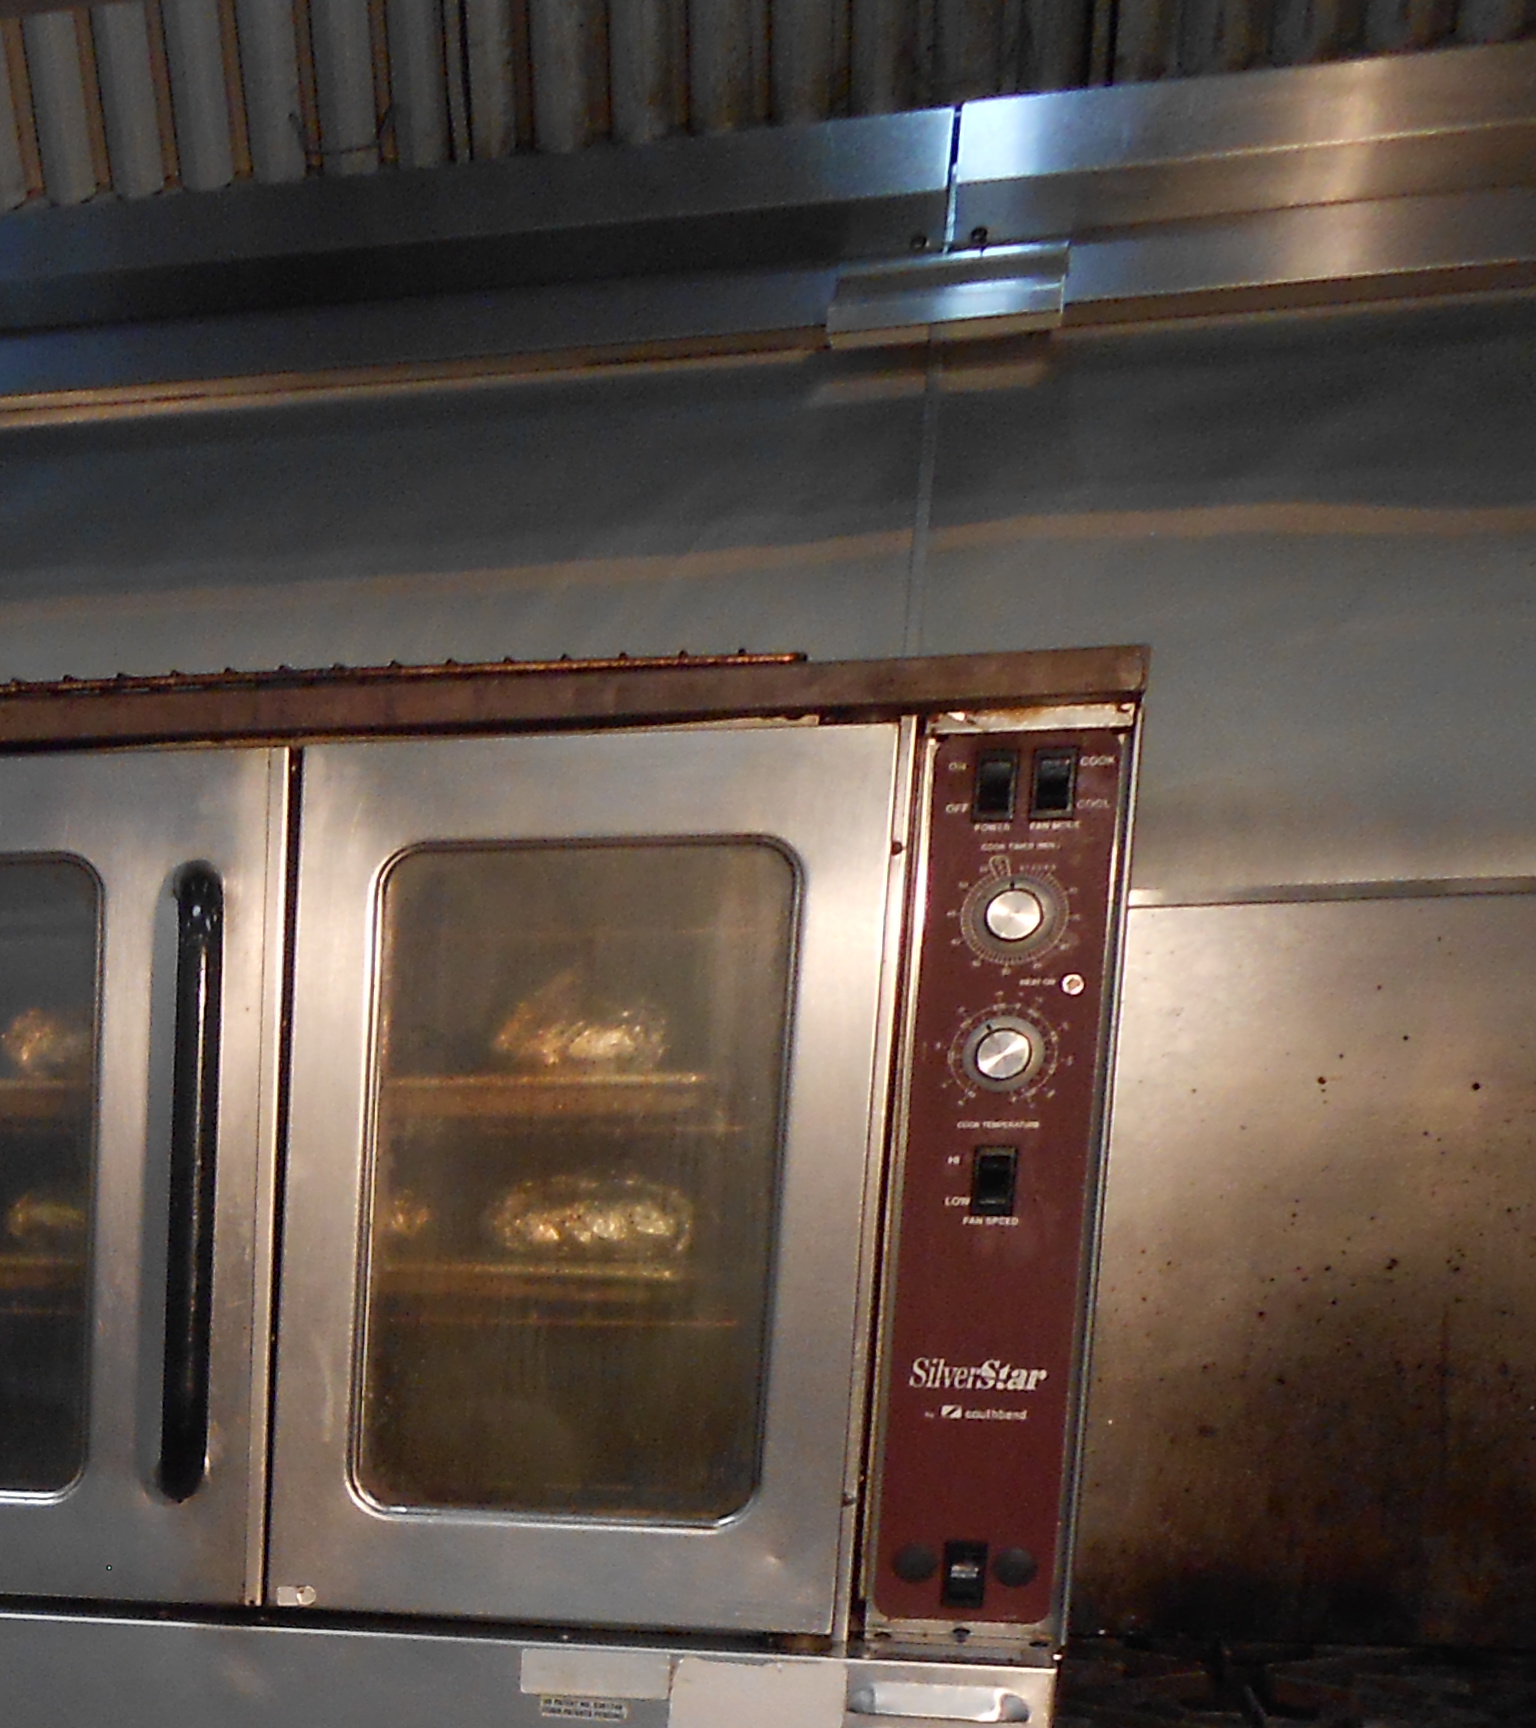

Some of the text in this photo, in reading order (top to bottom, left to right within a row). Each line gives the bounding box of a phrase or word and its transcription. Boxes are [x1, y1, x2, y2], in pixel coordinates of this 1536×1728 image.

[945, 803, 970, 813] OFF
[944, 1196, 971, 1206] LOW
[909, 1357, 1048, 1391] SilverStar
